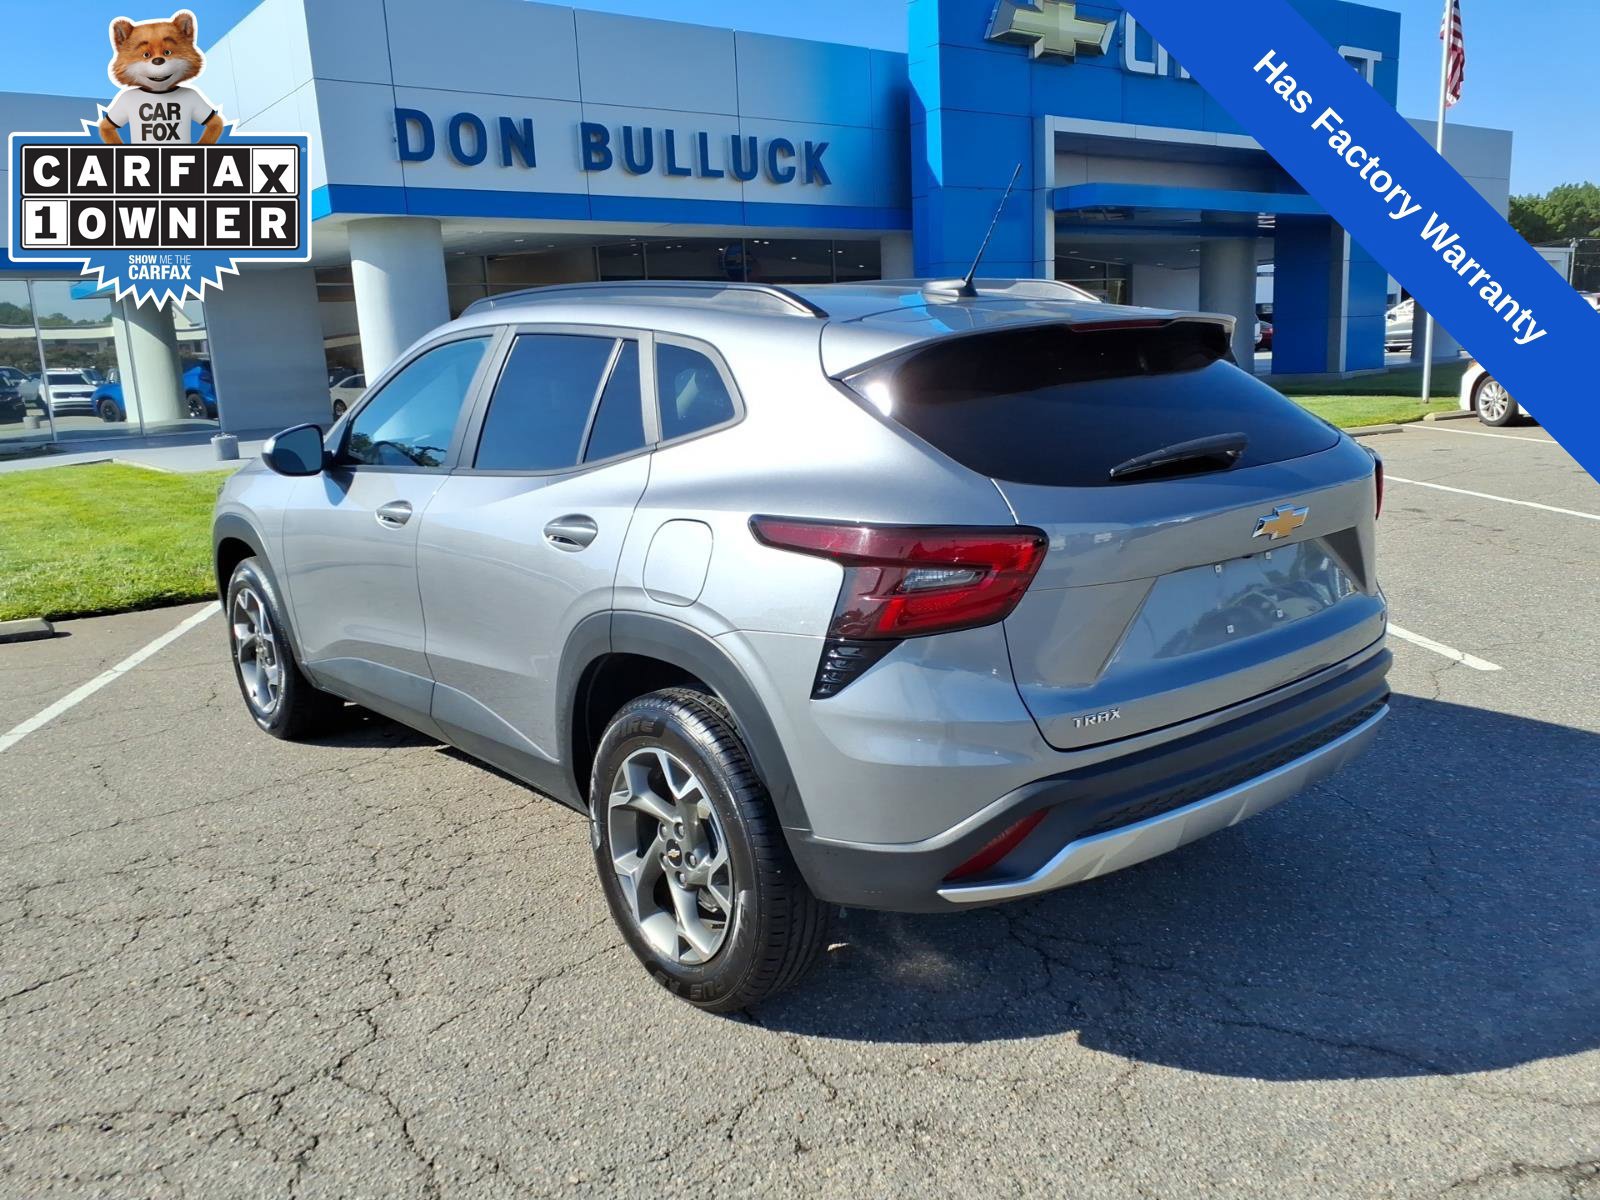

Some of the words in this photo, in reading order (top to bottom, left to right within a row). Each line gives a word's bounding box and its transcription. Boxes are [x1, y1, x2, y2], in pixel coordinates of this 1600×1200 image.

[394, 107, 537, 168] DON
[578, 121, 832, 186] BULLUCK
[1072, 708, 1121, 728] TRAX
